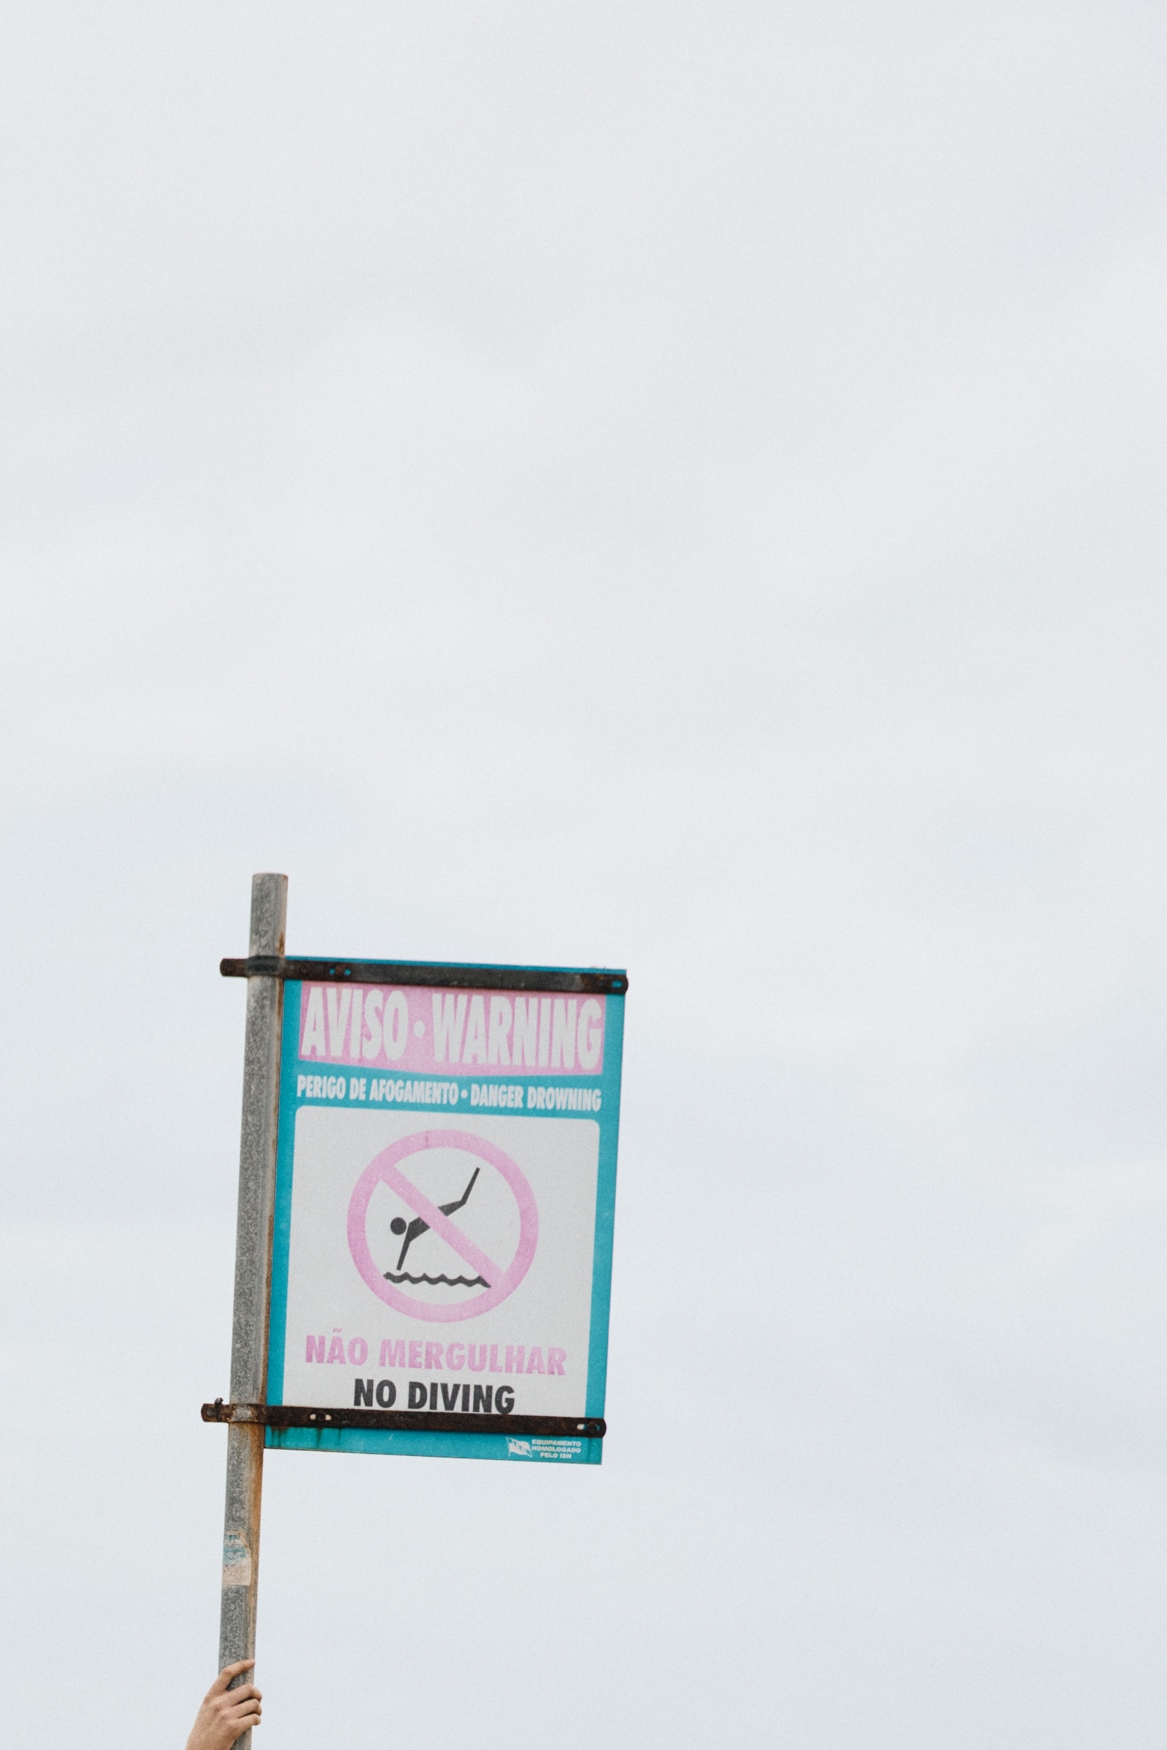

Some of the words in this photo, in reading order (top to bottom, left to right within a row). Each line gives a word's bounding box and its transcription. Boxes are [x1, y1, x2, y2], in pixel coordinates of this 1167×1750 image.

[301, 987, 409, 1061] AVISO
[432, 993, 602, 1070] WARNING
[296, 1074, 347, 1100] PERIGO
[349, 1077, 367, 1101] DE
[369, 1078, 459, 1106] AFOGAMENTO
[470, 1083, 524, 1109] DANGER
[527, 1086, 602, 1112] DROWNING
[305, 1328, 368, 1365] NÃO
[379, 1339, 566, 1375] MERGULHAR
[353, 1378, 397, 1409] NO
[407, 1380, 515, 1415] DIVING
[532, 1439, 582, 1447] EQUIPAMENTO
